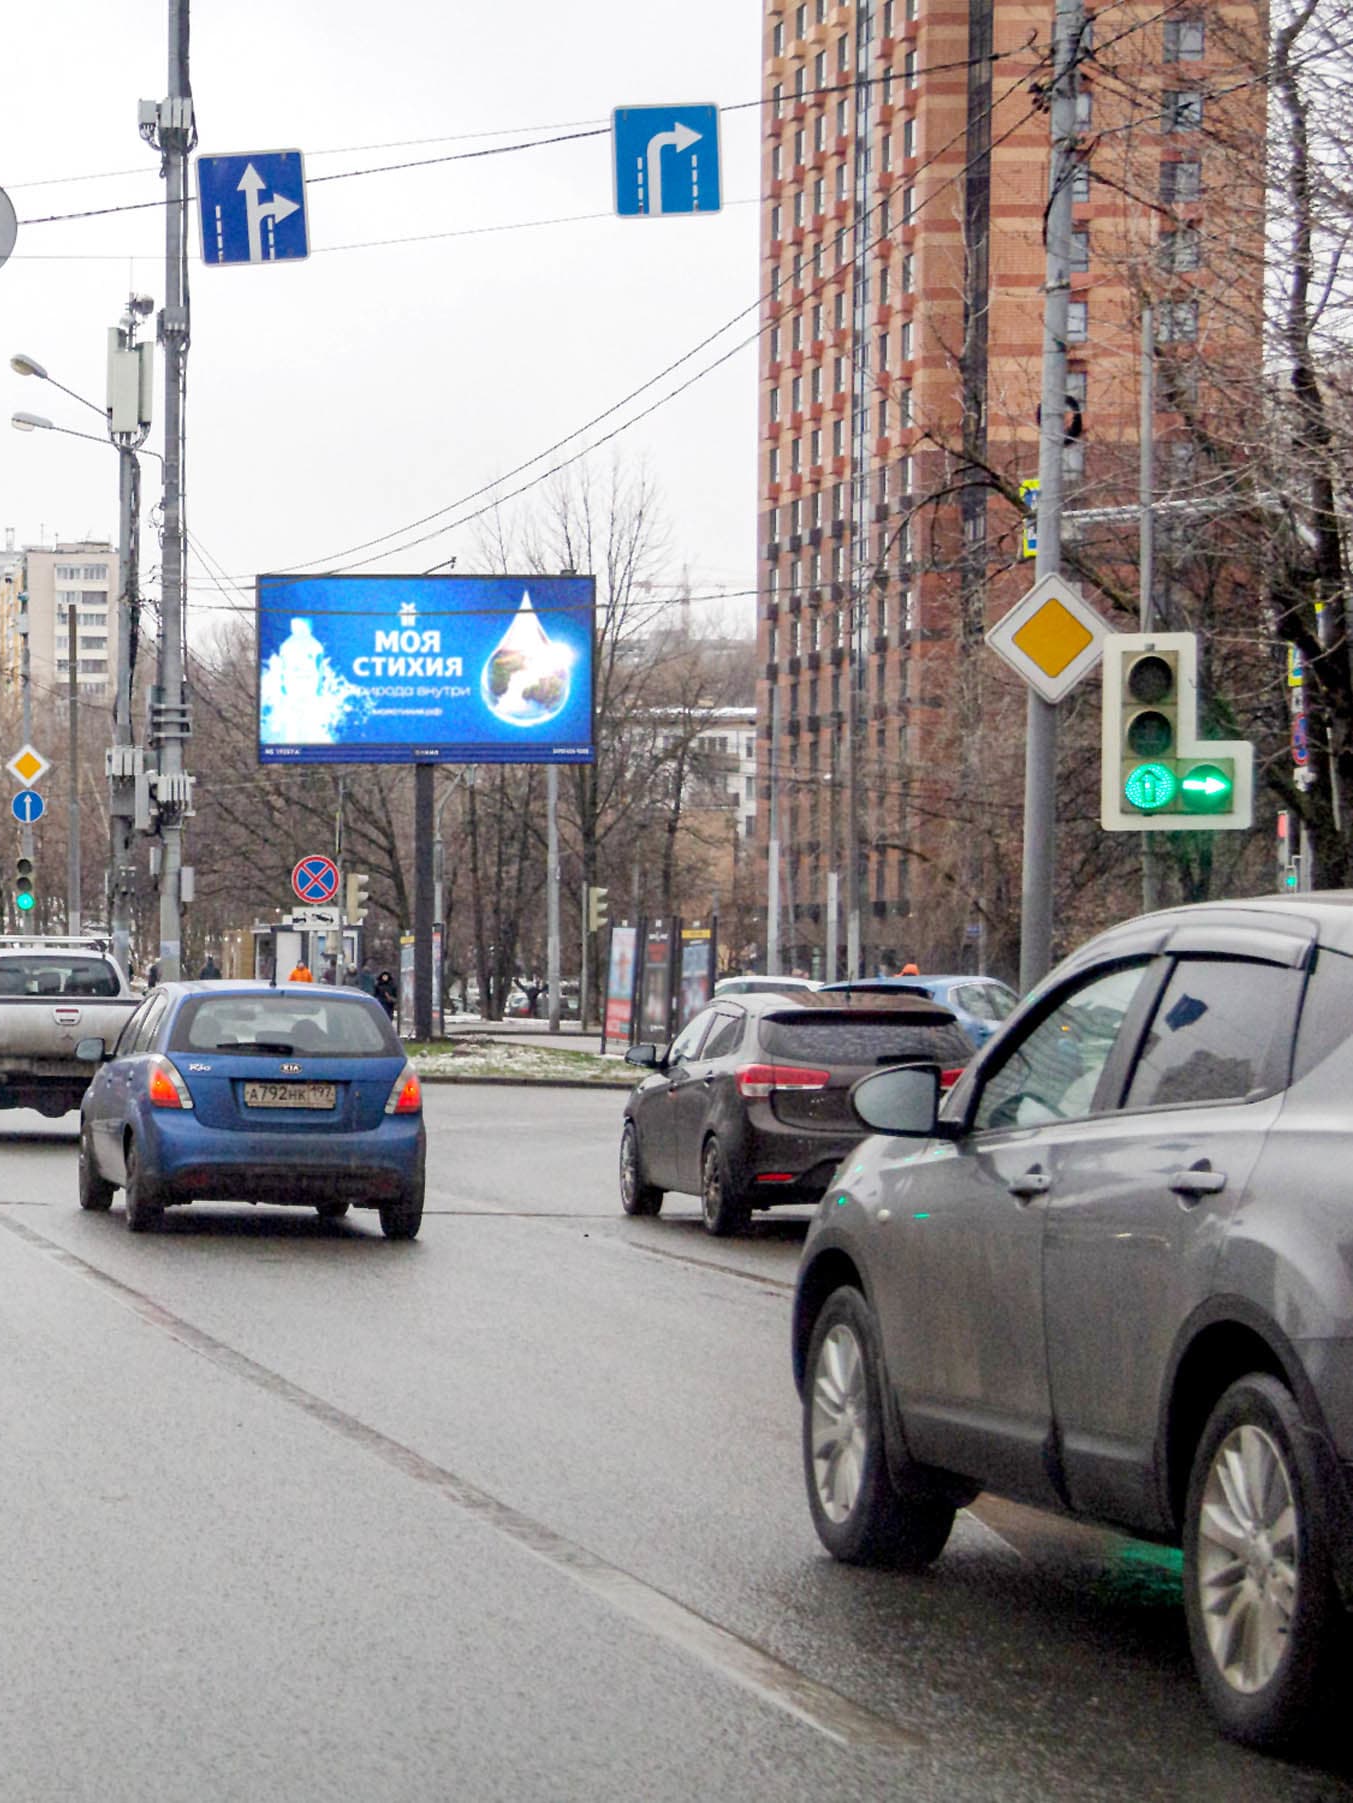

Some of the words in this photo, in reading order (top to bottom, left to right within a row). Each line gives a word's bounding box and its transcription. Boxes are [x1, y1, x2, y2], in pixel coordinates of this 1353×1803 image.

[375, 630, 440, 653] МОЯ
[352, 656, 463, 677] СТИХИЯ
[349, 685, 415, 697] рирода
[416, 685, 471, 699] внутри
[282, 1063, 300, 1072] KIA
